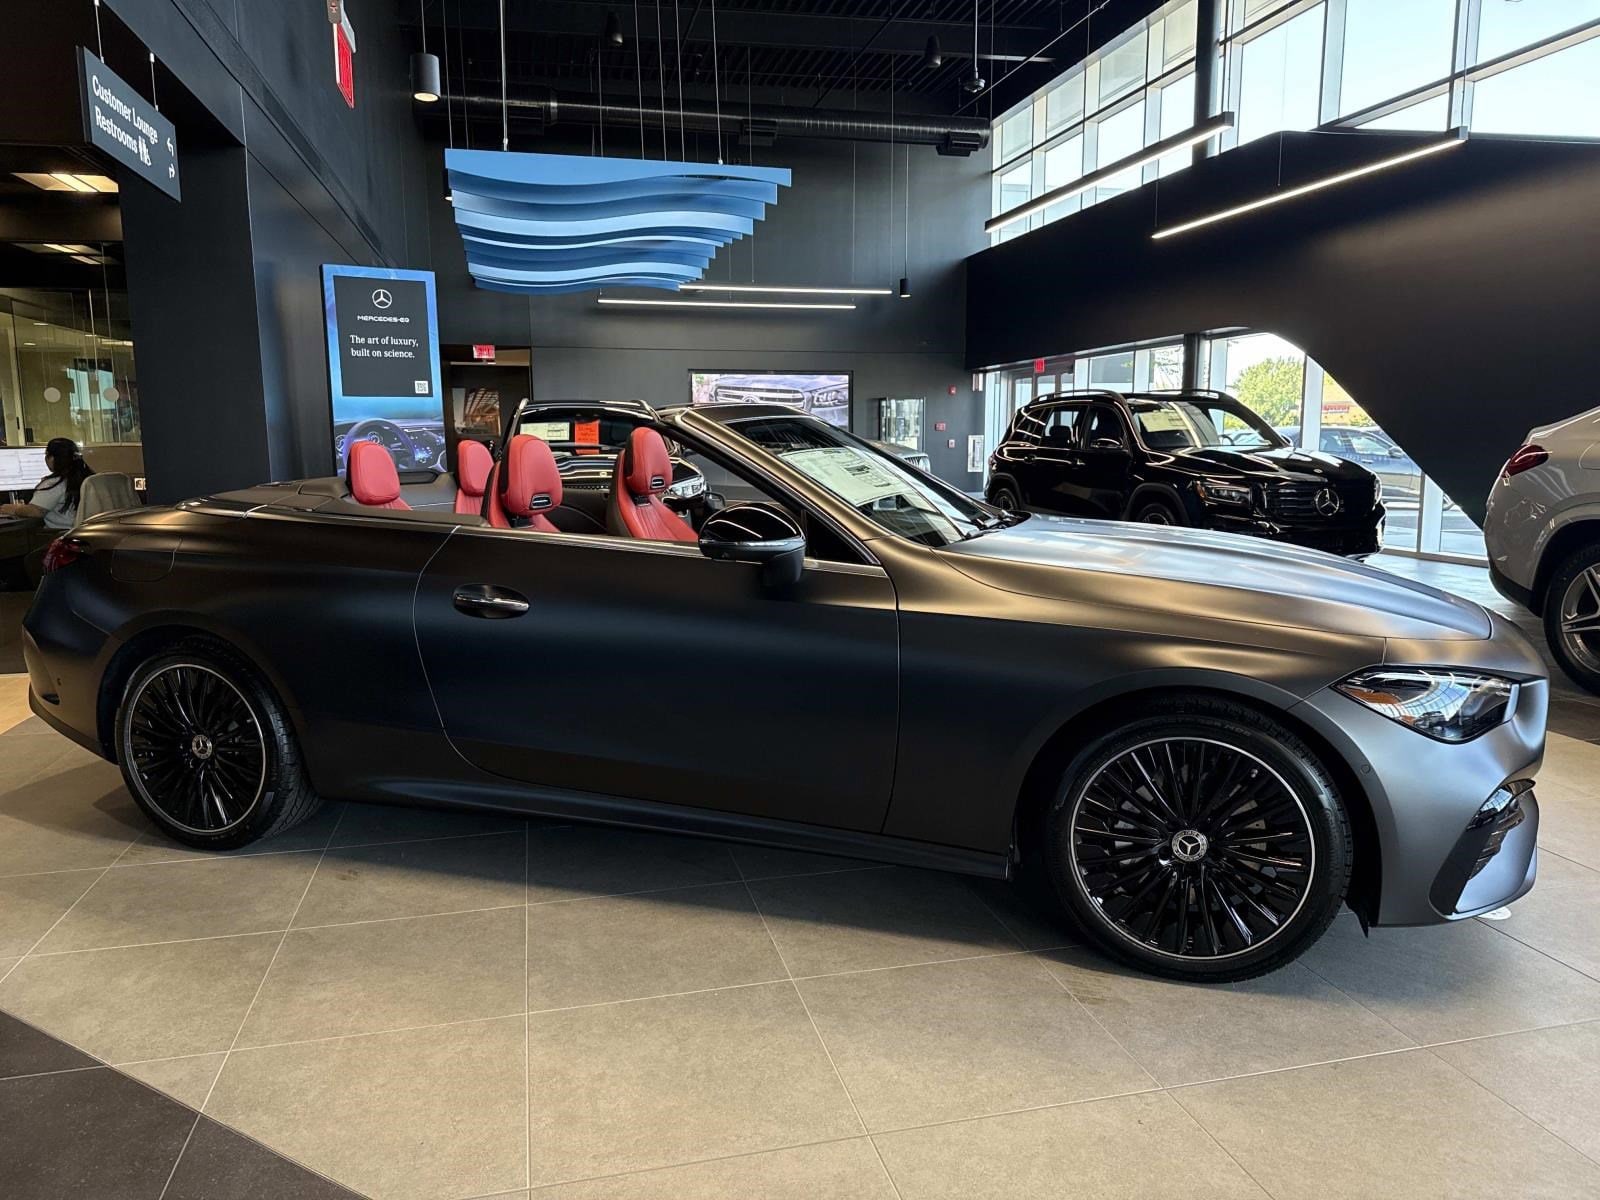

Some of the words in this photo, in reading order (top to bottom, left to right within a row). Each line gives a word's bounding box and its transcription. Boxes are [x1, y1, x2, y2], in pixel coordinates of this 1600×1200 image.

[92, 75, 132, 122] Customer
[132, 106, 158, 144] Lounge
[95, 105, 138, 154] Restrooms
[349, 334, 366, 344] The
[367, 336, 379, 345] art
[380, 336, 390, 345] of
[390, 336, 419, 348] luxury,
[350, 348, 370, 357] built
[371, 349, 382, 357] on
[383, 349, 415, 358] science.
